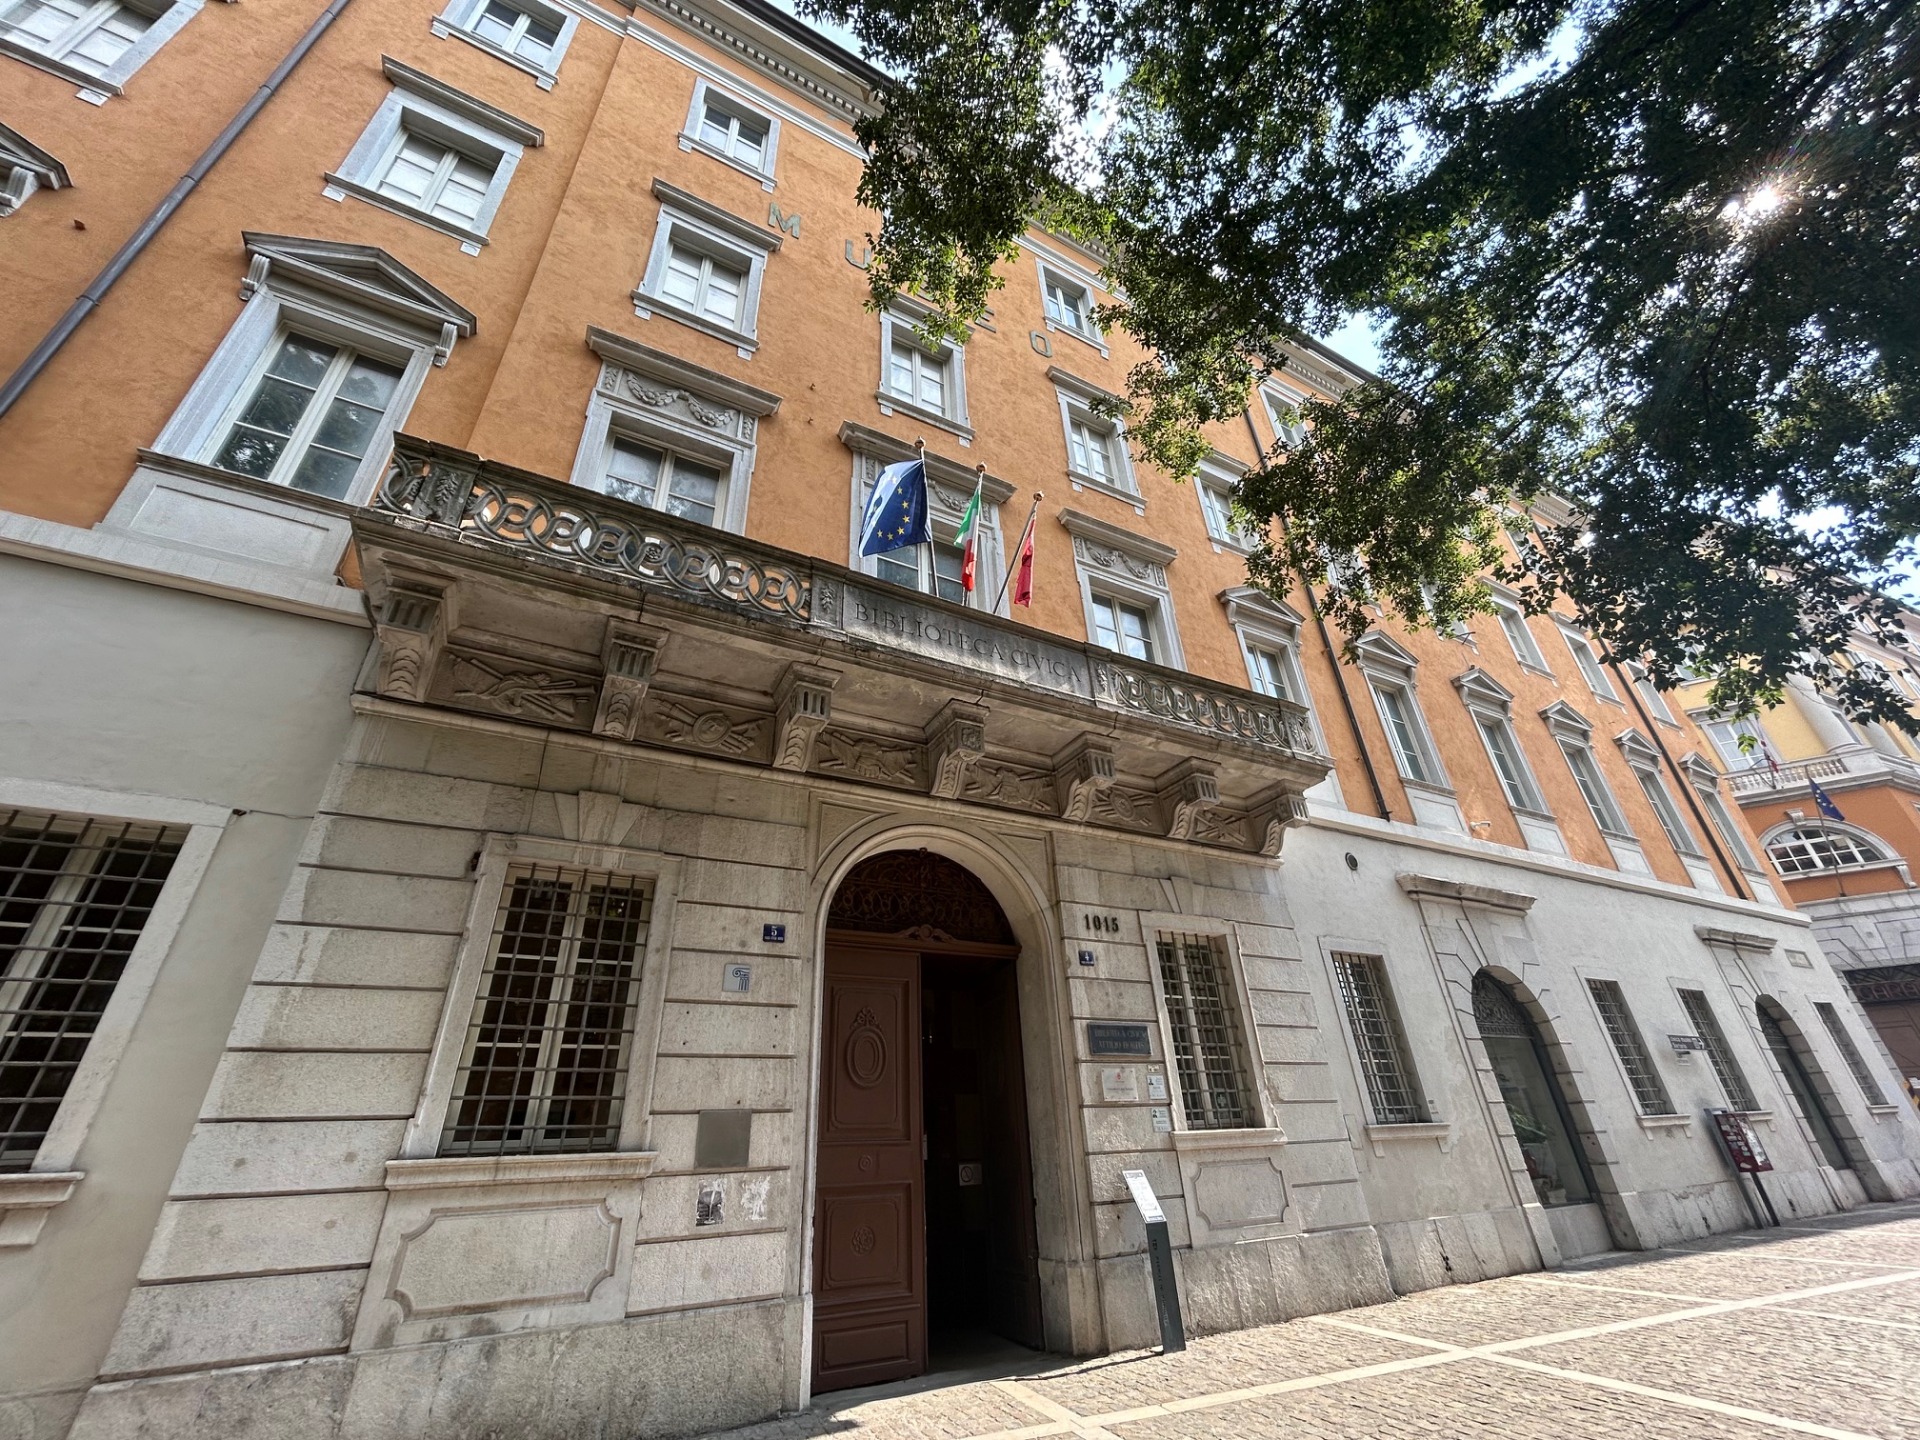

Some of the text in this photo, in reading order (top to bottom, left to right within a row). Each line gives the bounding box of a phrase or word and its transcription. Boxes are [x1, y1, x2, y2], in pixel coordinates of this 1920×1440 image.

[767, 201, 1053, 359] MUEO
[855, 603, 1081, 682] BIBLIOTECA CIVICA
[771, 926, 777, 936] 5
[1084, 914, 1119, 932] 1015
